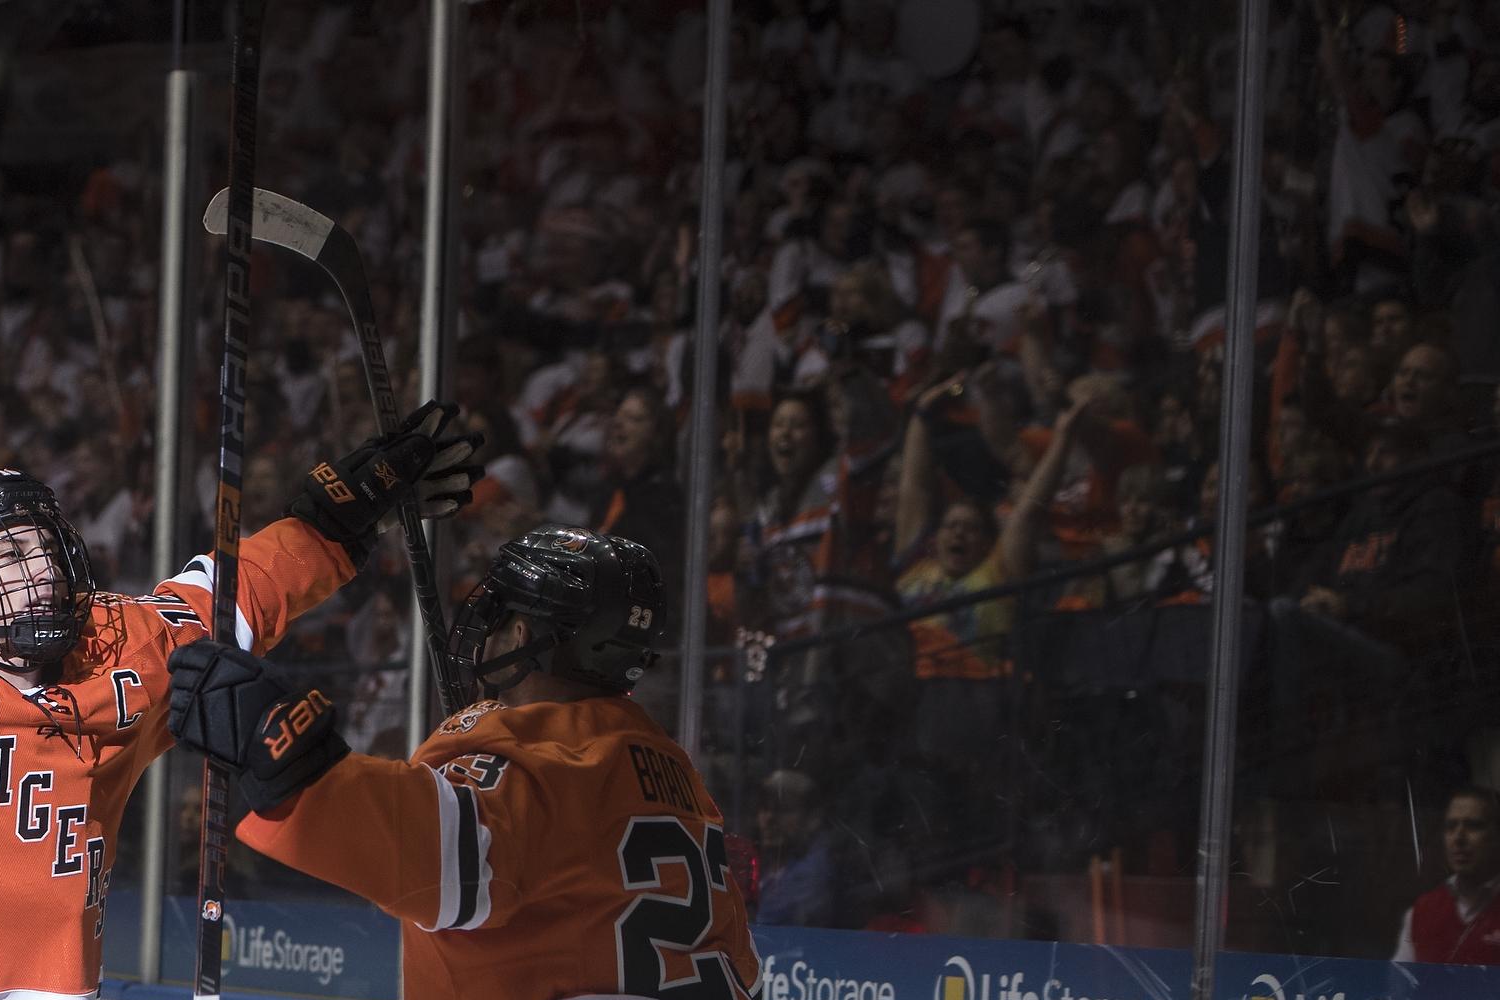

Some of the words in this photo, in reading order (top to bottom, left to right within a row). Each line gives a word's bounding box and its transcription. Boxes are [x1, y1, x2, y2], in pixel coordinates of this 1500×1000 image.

[627, 604, 654, 630] 23
[110, 668, 143, 731] C
[263, 688, 333, 761] UER
[238, 925, 345, 986] LifeStorage
